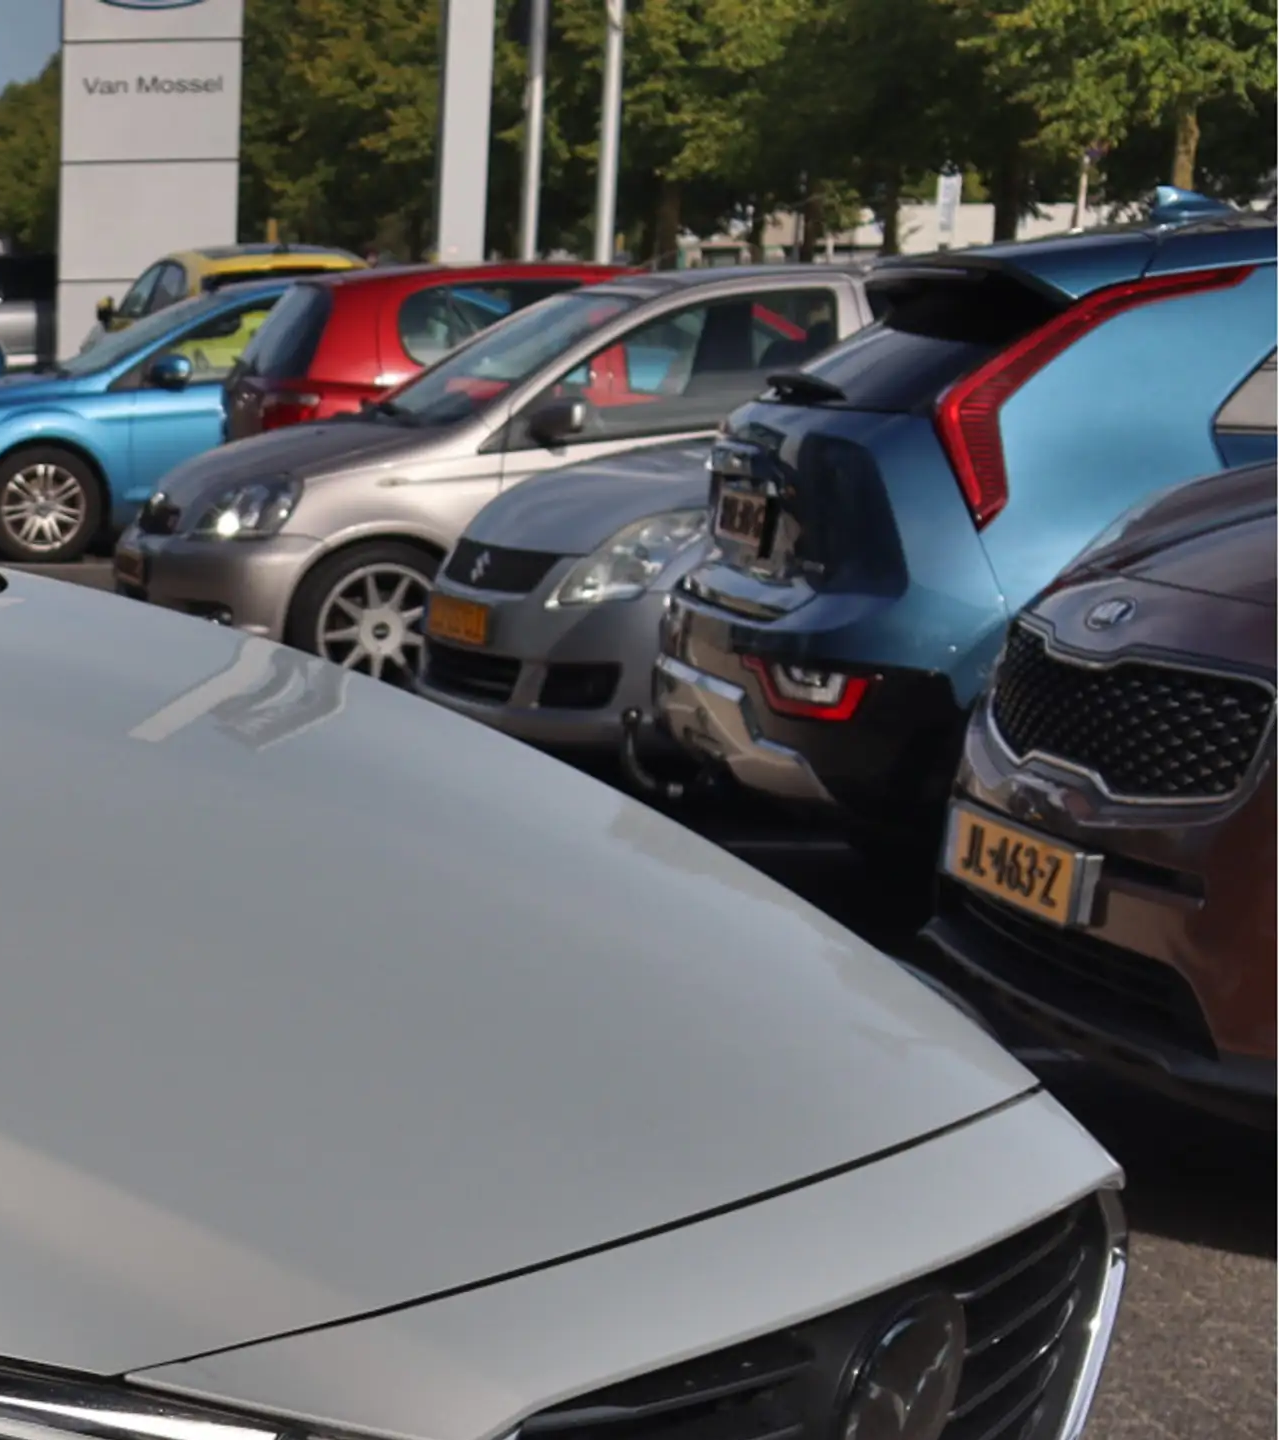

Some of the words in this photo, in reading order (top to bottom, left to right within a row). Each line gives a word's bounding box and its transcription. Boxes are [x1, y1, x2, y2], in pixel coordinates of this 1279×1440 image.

[82, 77, 129, 96] Van
[135, 74, 224, 95] Mossel
[961, 824, 1062, 908] JL-463-Z
